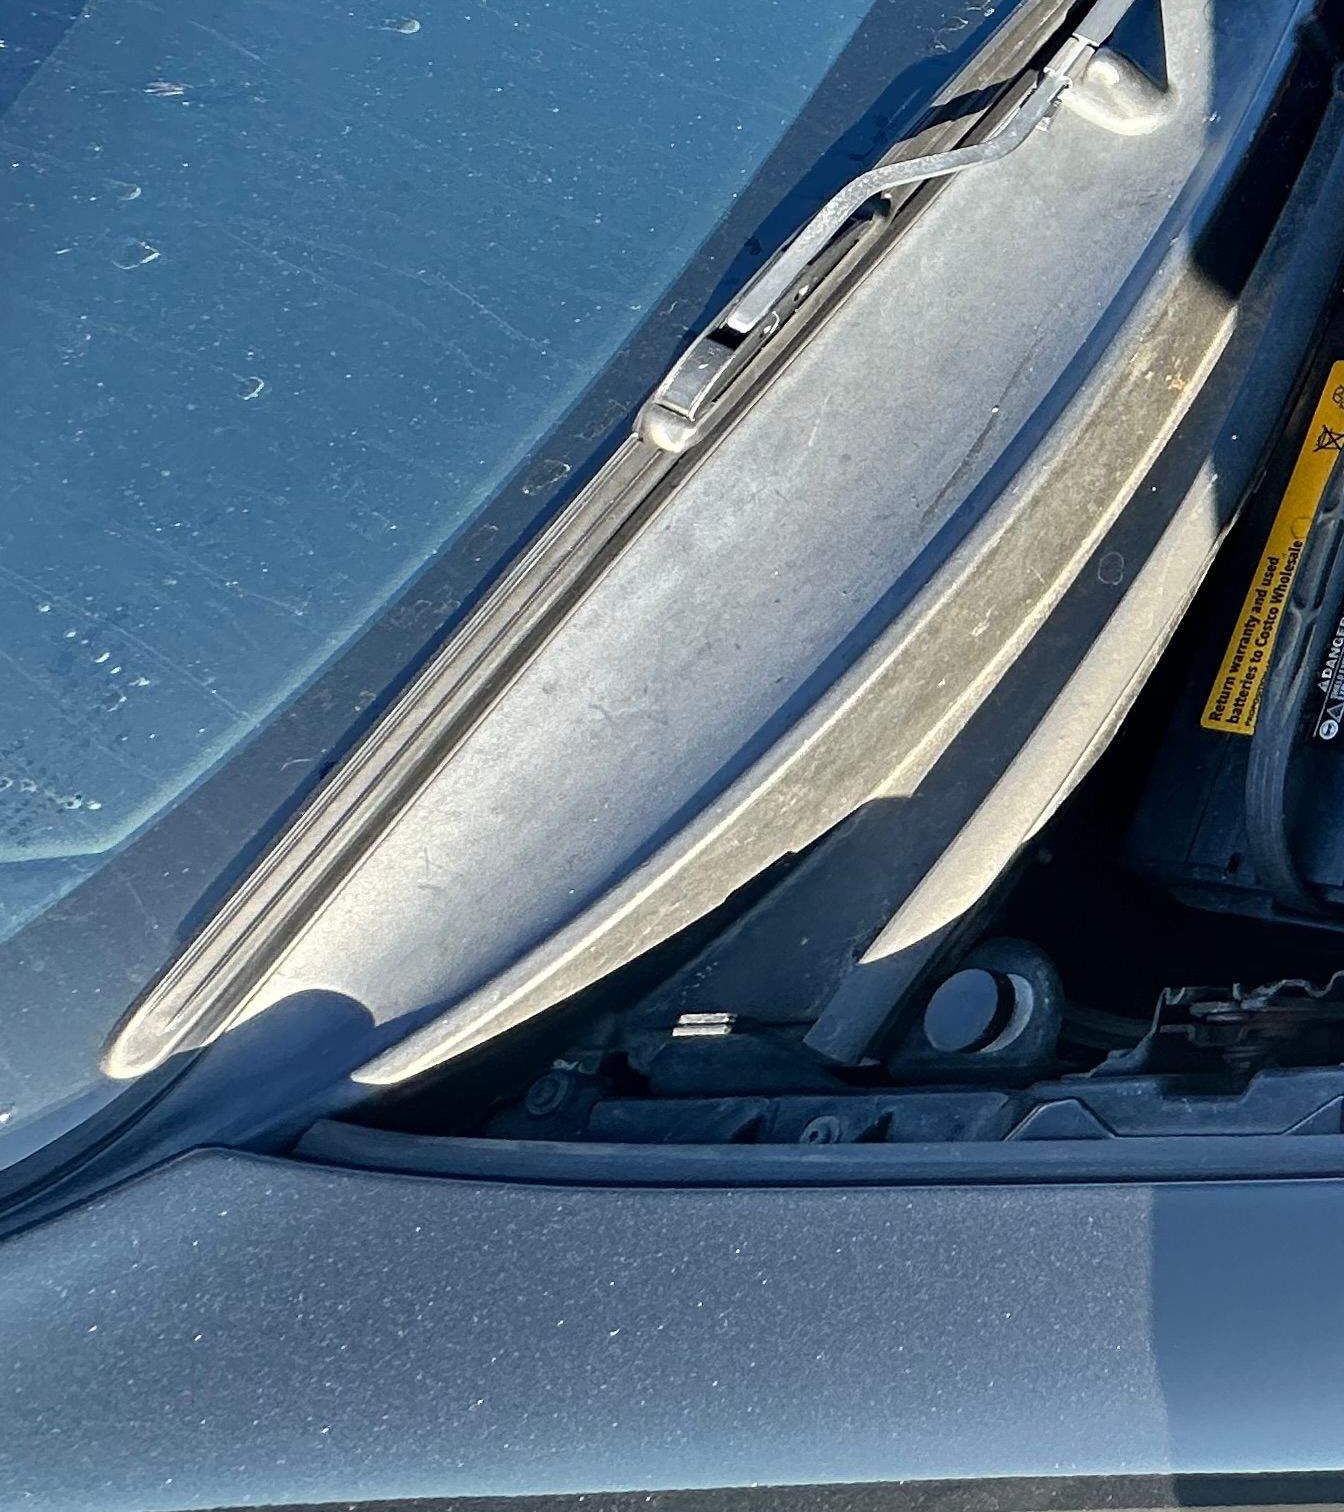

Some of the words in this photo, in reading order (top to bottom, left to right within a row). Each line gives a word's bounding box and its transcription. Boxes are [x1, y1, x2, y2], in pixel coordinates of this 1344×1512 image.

[1268, 540, 1303, 604] Wholesale
[1207, 676, 1235, 721] Return
[1226, 615, 1260, 673] warranty
[1247, 588, 1267, 612] and
[1257, 556, 1279, 585] used
[1254, 606, 1280, 646] Costco
[1249, 649, 1264, 662] to
[1225, 666, 1258, 724] batteries
